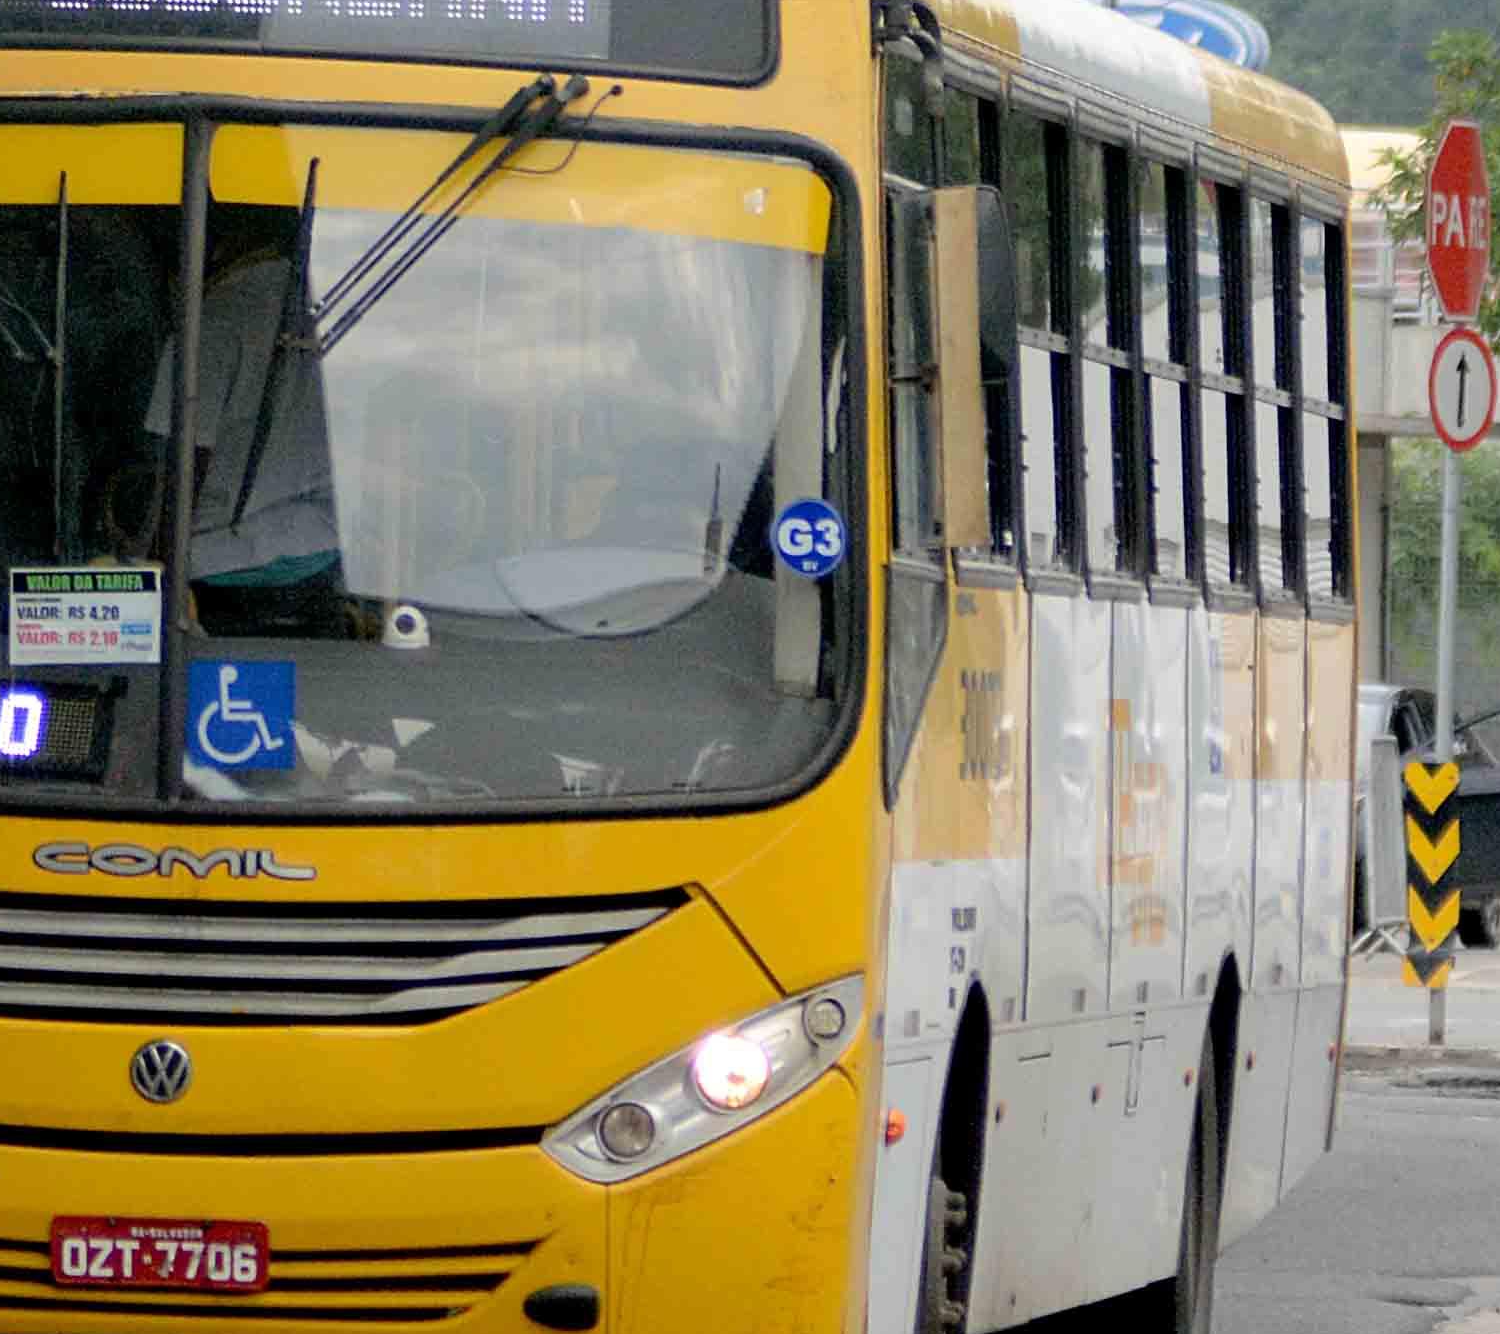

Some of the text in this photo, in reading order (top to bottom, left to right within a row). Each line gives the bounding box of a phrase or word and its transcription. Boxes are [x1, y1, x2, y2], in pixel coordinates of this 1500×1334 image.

[1432, 193, 1488, 250] PARE
[777, 517, 841, 556] G3
[26, 574, 143, 591] VALOR DA TARIFA
[33, 841, 316, 879] COMIL
